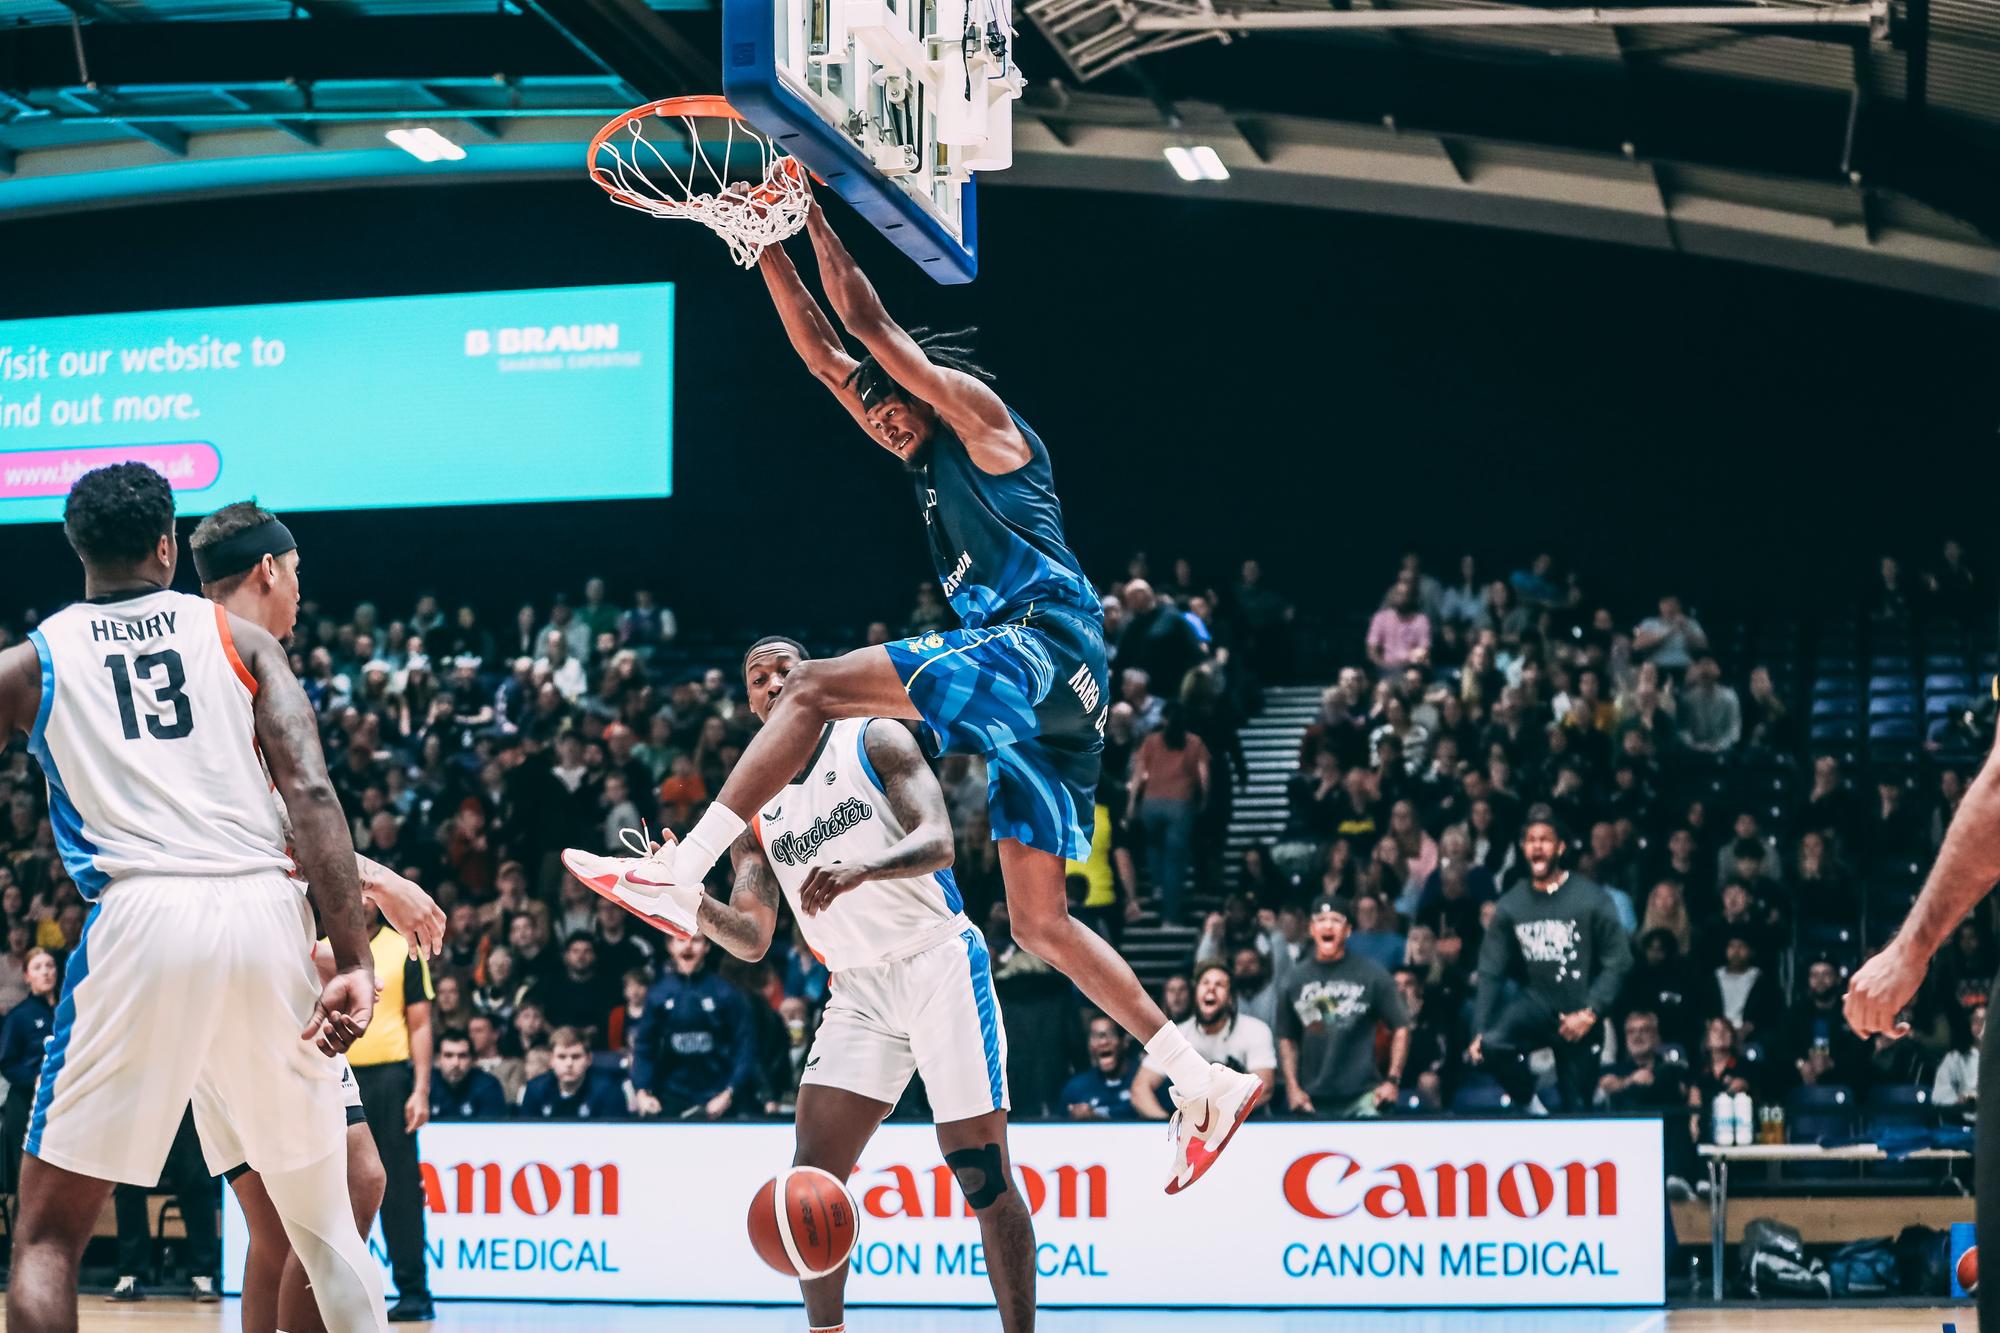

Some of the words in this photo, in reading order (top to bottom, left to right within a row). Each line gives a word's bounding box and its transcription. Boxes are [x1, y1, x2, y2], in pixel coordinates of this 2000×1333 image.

[498, 322, 619, 355] BRAUN
[58, 351, 113, 378] our
[121, 336, 242, 375] website
[252, 336, 286, 368] to
[51, 392, 103, 426] out
[113, 391, 201, 422] more.
[91, 611, 177, 642] HENRY
[104, 648, 194, 740] 13
[1282, 1151, 1618, 1219] Canon
[458, 1238, 620, 1273] MEDICAL
[936, 1241, 1109, 1276] MECAL
[1282, 1242, 1424, 1278] CANON
[1440, 1241, 1619, 1277] MEDICAL
